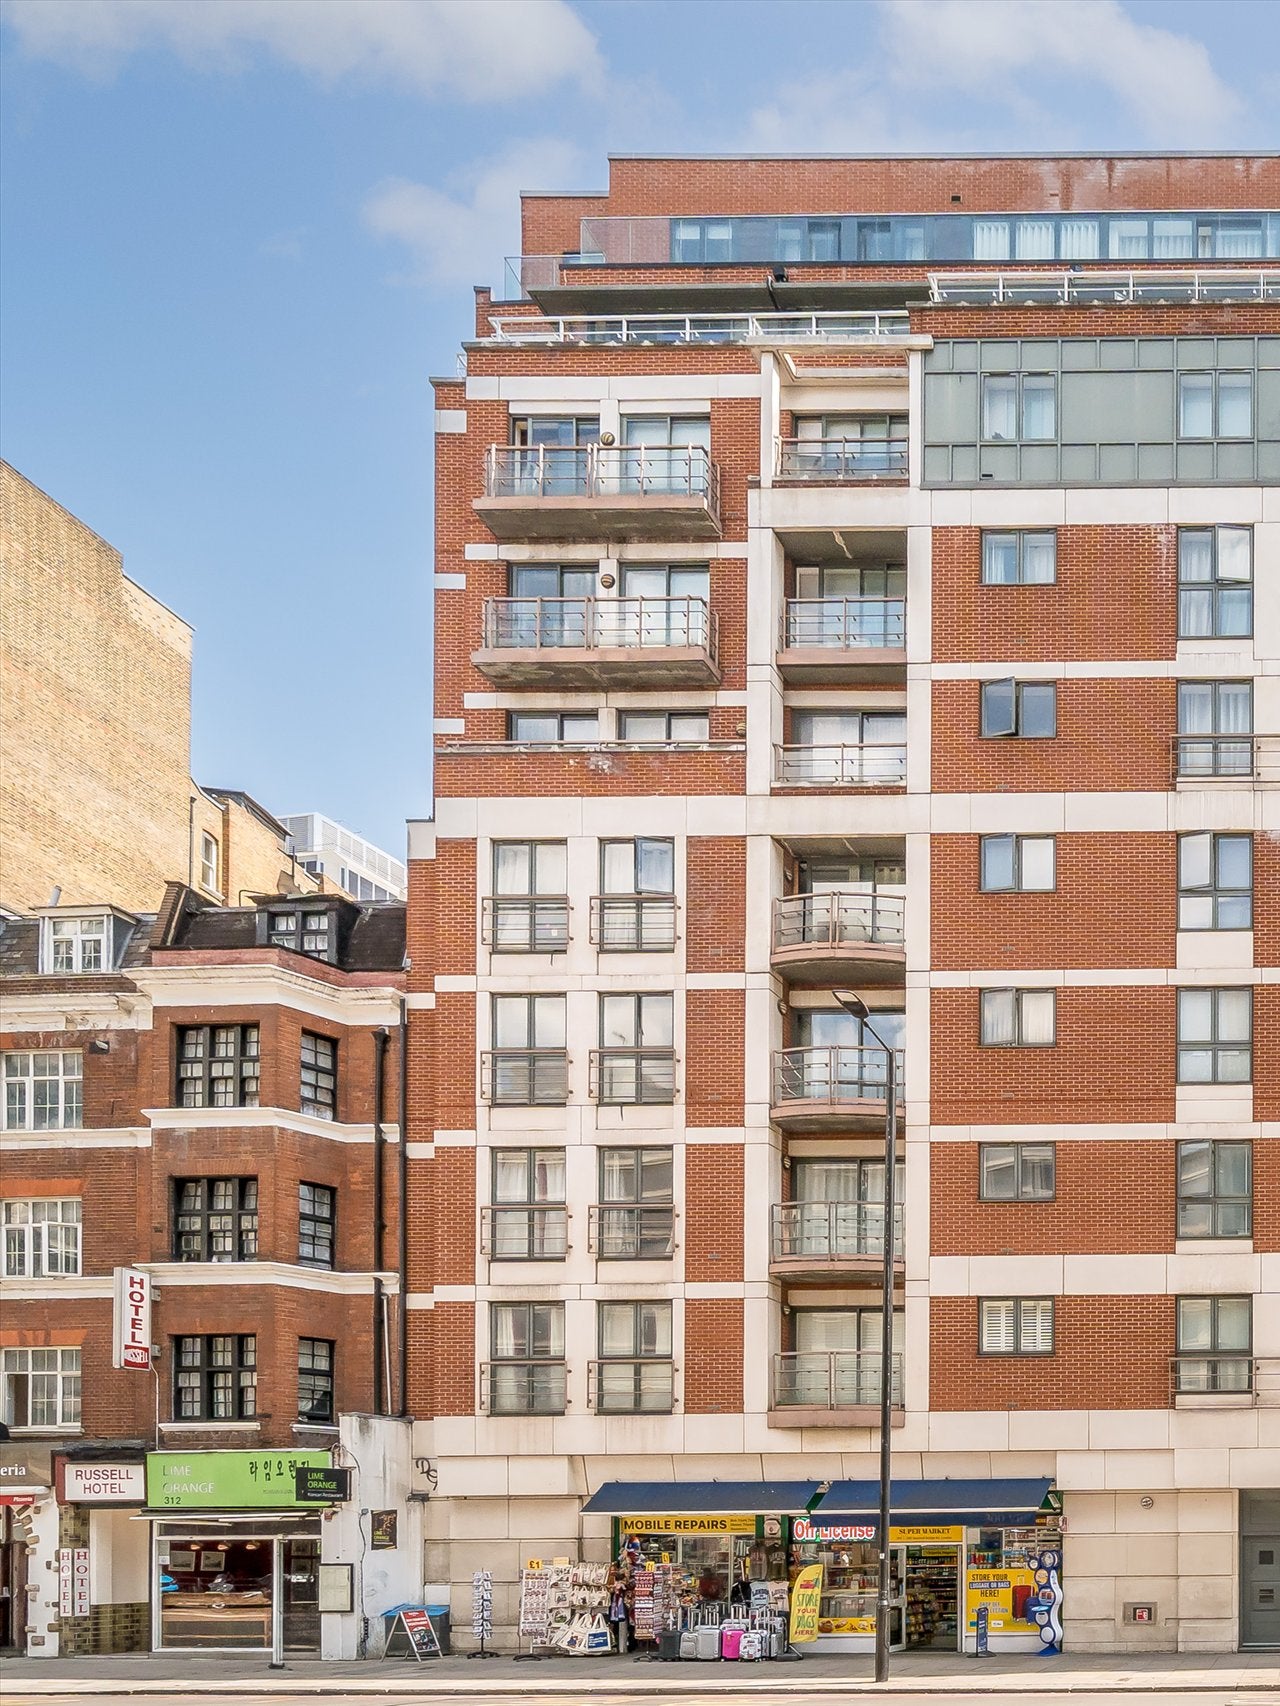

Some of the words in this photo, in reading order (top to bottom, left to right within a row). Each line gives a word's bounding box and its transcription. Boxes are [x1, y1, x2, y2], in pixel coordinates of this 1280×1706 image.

[128, 1275, 145, 1344] HOTEL
[0, 1464, 26, 1476] eria
[75, 1469, 133, 1480] RUSSELL
[162, 1465, 192, 1477] LIME
[307, 1472, 325, 1480] LIME
[83, 1483, 126, 1494] HOTEL
[162, 1482, 215, 1494] ORANGE
[307, 1481, 337, 1490] ORANGE
[164, 1496, 181, 1505] 312
[624, 1519, 671, 1530] MOBILE
[674, 1519, 727, 1530] REPAIRS
[529, 1560, 540, 1569] £1
[61, 1552, 70, 1614] HOTEL
[76, 1551, 88, 1613] HOTEL
[980, 1589, 999, 1597] HERE!
[796, 1593, 819, 1607] STORE
[796, 1615, 815, 1629] BAGS
